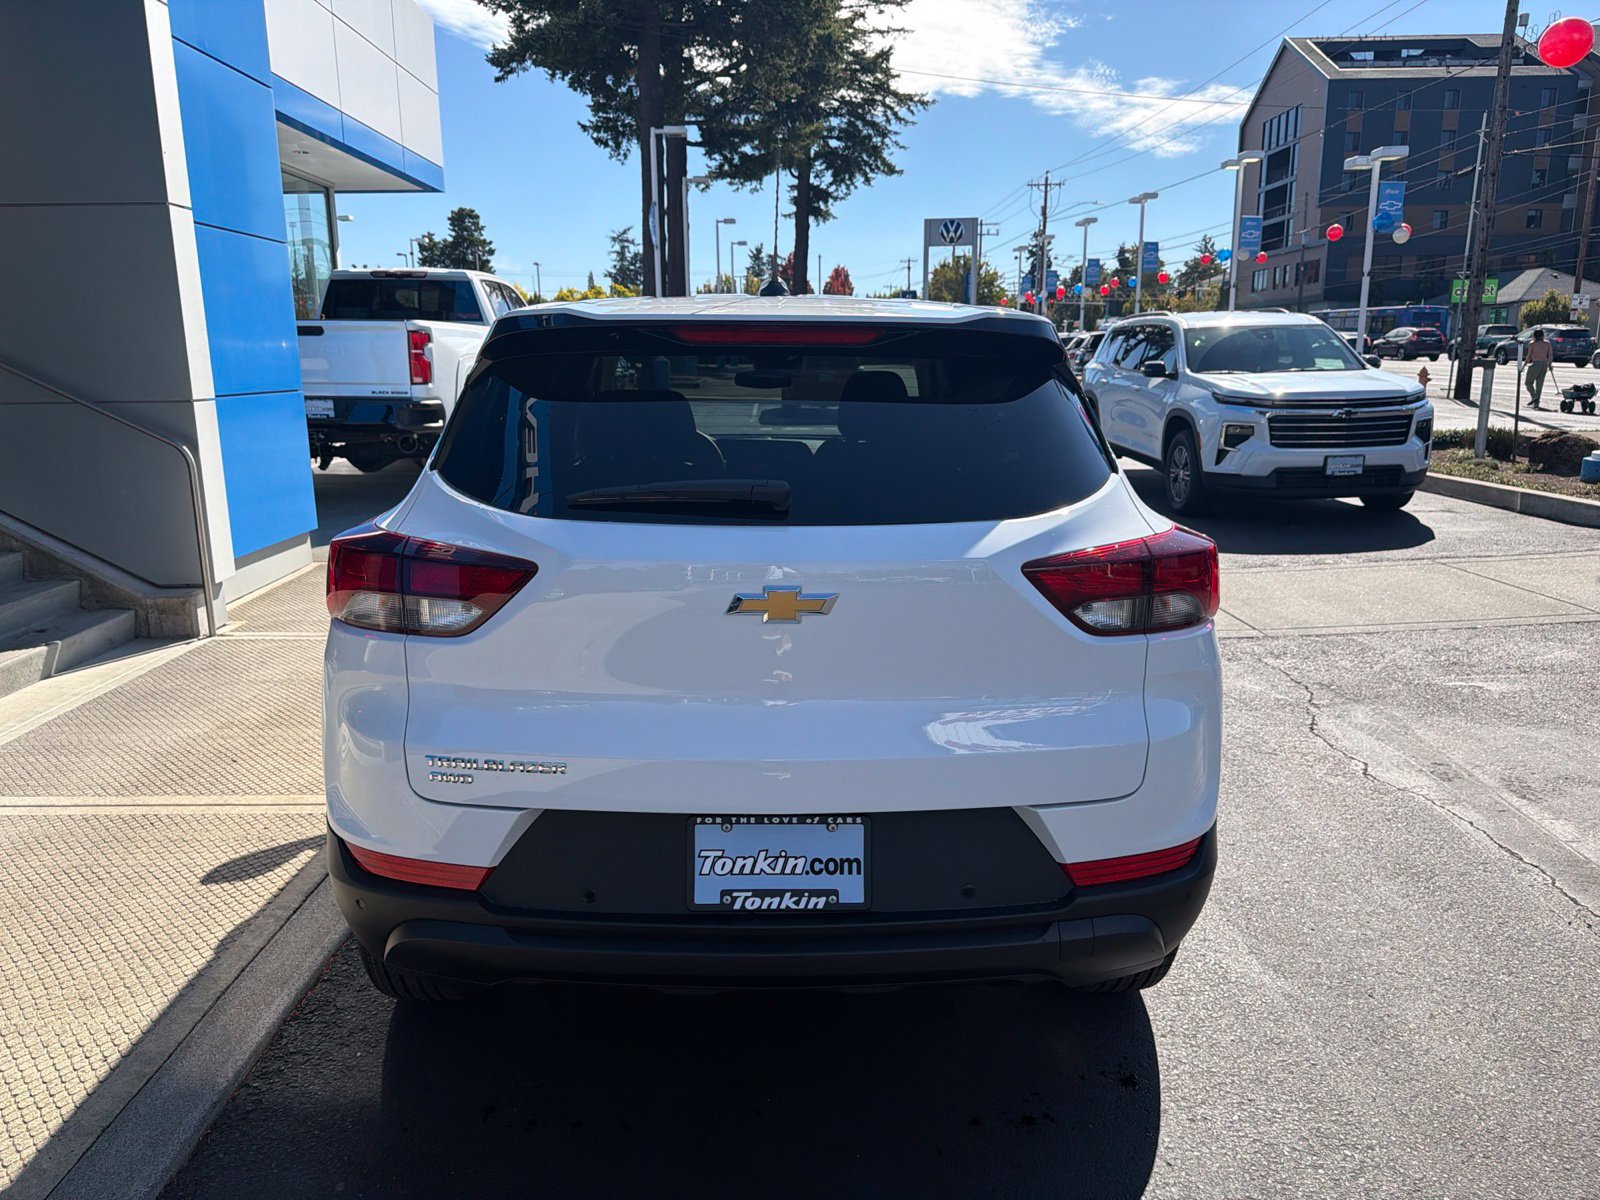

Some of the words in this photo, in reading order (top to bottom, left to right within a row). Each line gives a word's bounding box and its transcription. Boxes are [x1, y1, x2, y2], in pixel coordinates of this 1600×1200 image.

[424, 754, 567, 774] TRAILBLAZER
[428, 771, 474, 784] AWD
[696, 816, 723, 824] FOR
[731, 816, 756, 824] THE
[763, 816, 798, 824] LOVE
[827, 816, 863, 824] CARS
[698, 849, 862, 876] Tonkin.com
[731, 891, 827, 910] Tonkin
